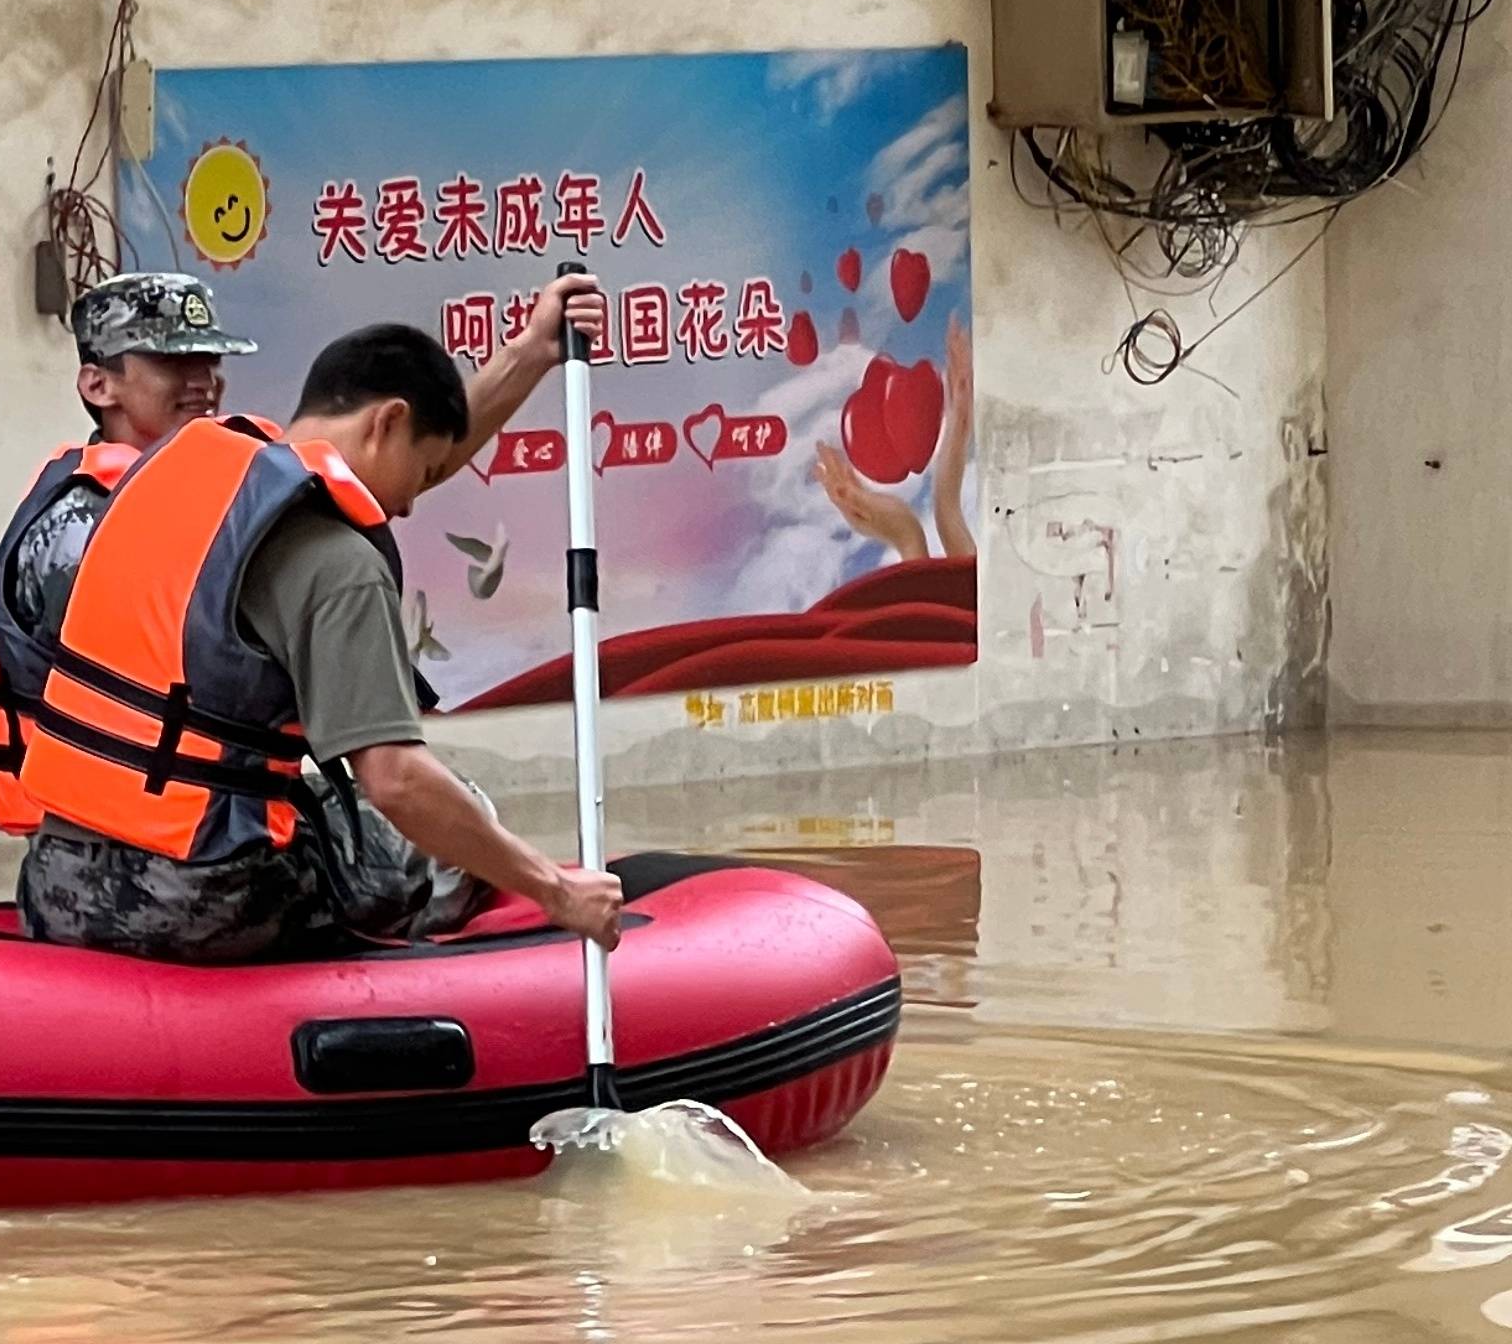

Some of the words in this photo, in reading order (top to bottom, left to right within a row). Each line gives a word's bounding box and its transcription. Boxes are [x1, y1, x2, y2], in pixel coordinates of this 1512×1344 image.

[315, 171, 665, 261] 关爱未成年人
